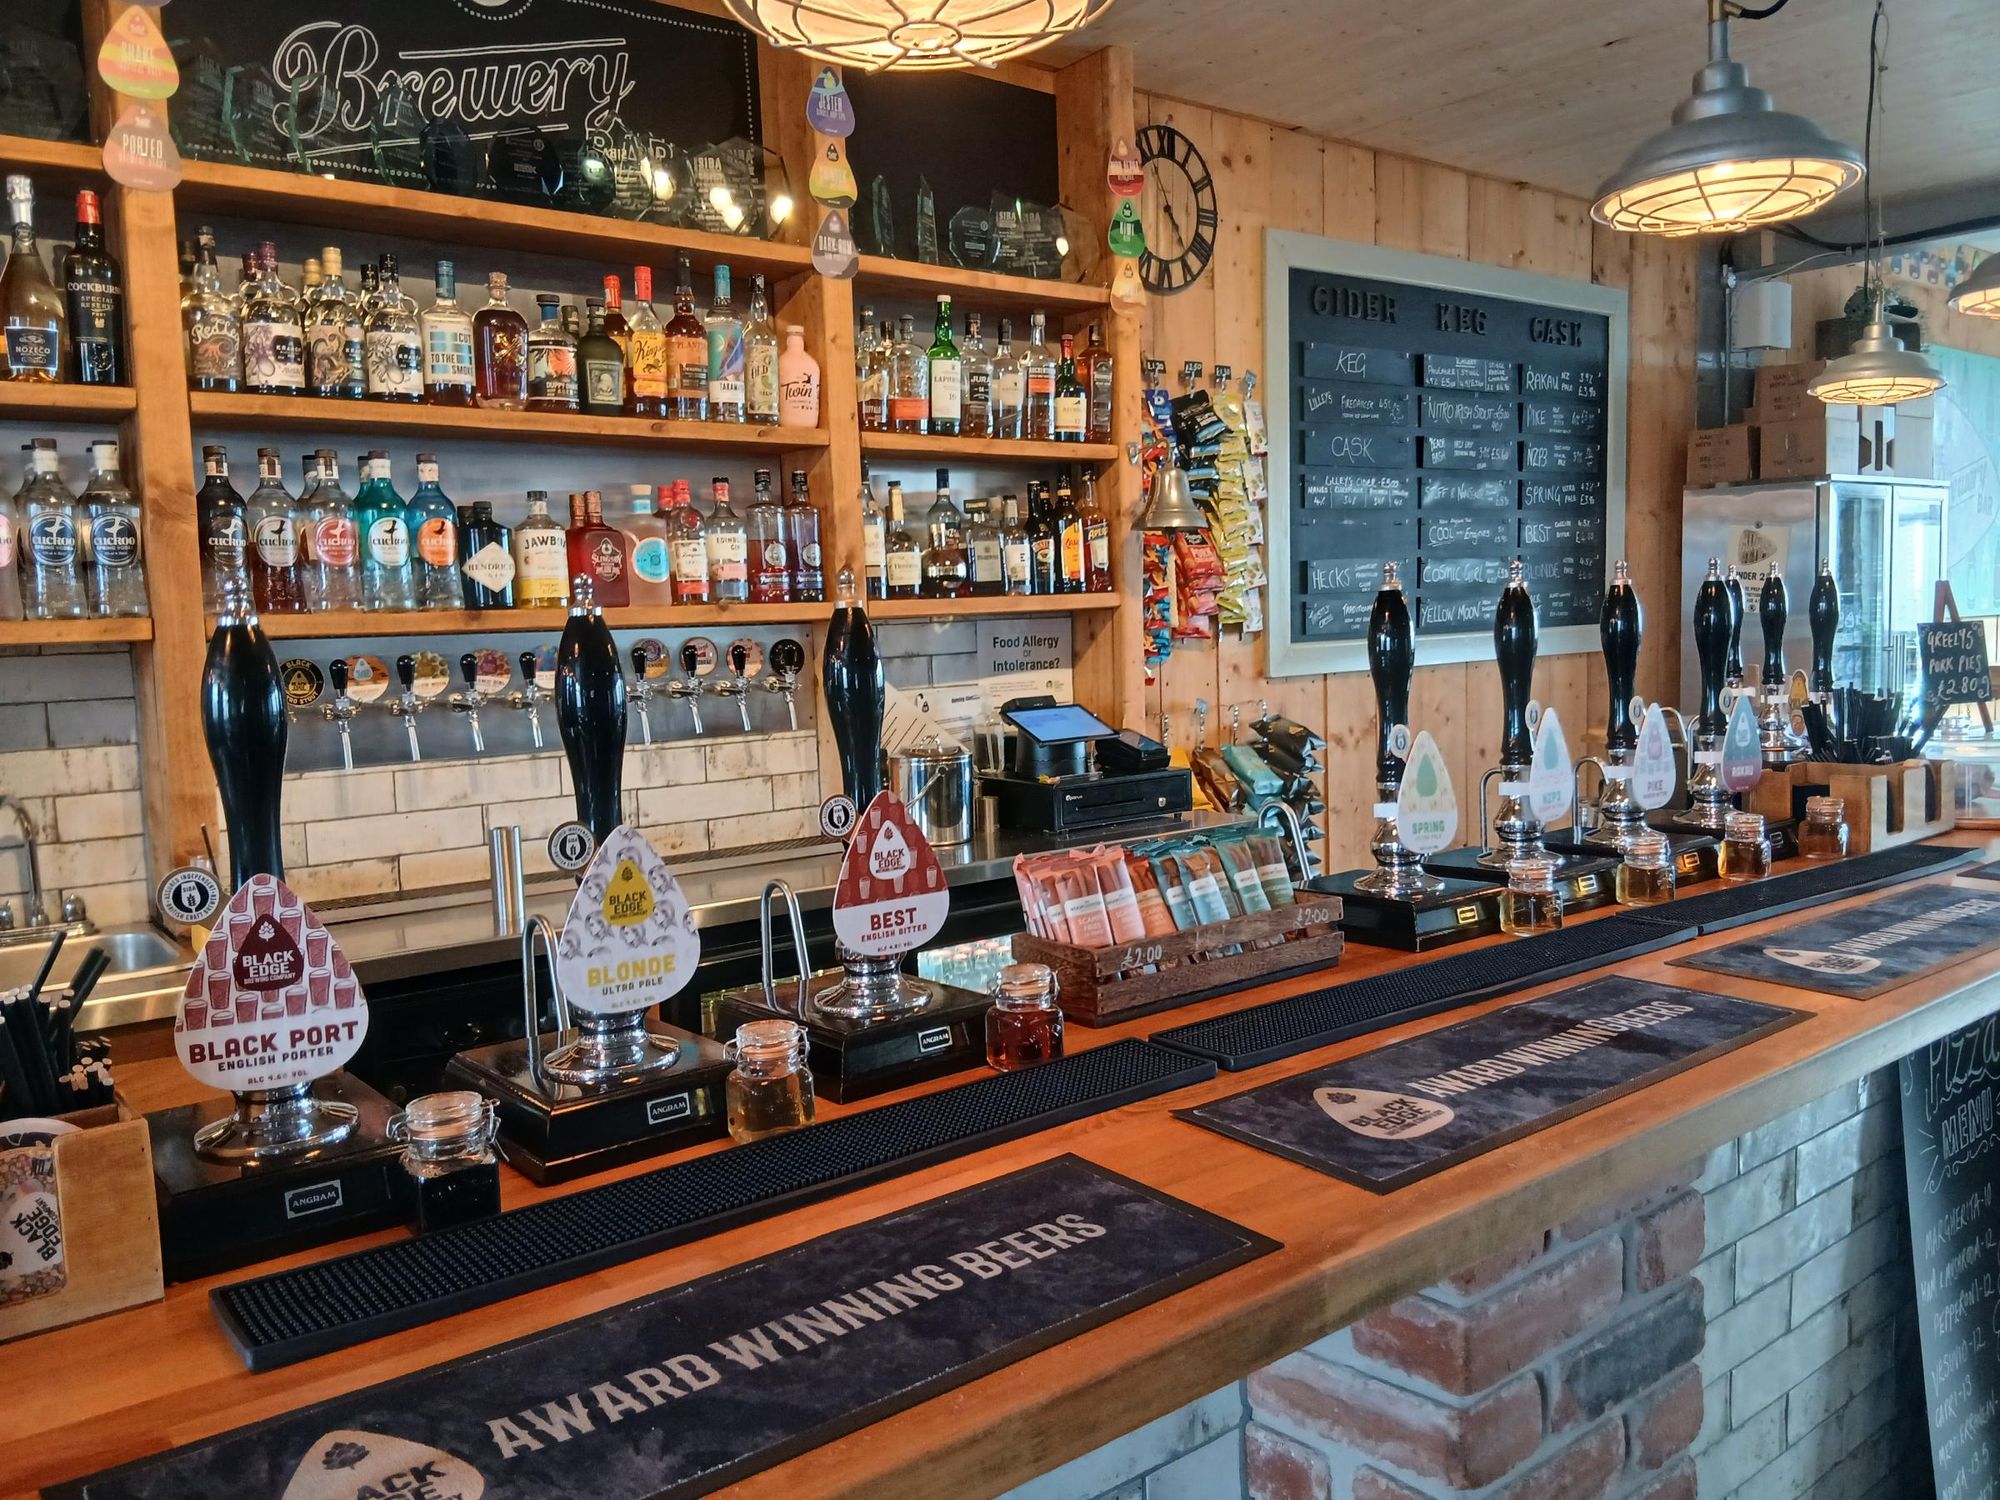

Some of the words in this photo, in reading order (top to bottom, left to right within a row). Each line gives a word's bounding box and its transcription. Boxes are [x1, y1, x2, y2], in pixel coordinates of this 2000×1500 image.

[272, 21, 636, 137] Brewery
[1312, 286, 1398, 323] CIDER
[1438, 303, 1488, 336] KEG
[1530, 317, 1583, 347] CASK
[15, 346, 51, 354] NOZECO
[431, 354, 440, 363] TO
[441, 354, 455, 364] THE
[1336, 350, 1367, 378] KEG
[1526, 371, 1559, 391] RAKAU
[1428, 402, 1454, 424] NITRO
[1526, 407, 1546, 428] PIKE
[1332, 436, 1375, 463] CASK
[1525, 486, 1561, 507] SPRING
[1525, 524, 1552, 544] BEST
[1312, 567, 1350, 590] HECKS
[1422, 563, 1461, 583] COSMIC
[1523, 562, 1561, 581] BLONDE
[1421, 605, 1455, 627] YELLOW
[1458, 601, 1481, 622] MOON
[993, 635, 1020, 649] Food
[1022, 634, 1060, 653] Allergy
[1022, 649, 1033, 658] or
[993, 657, 1061, 673] Intolerance?
[1929, 656, 1954, 676] PORK
[1958, 654, 1982, 674] PIES
[1411, 820, 1446, 835] SPRING
[874, 848, 905, 862] BLACK
[878, 857, 902, 869] EDGE
[609, 891, 648, 906] BLACK
[613, 902, 643, 915] EDGE
[870, 907, 917, 931] BEST
[861, 930, 896, 944] ENGLISH
[898, 923, 928, 937] BITTER
[242, 950, 295, 967] BLACK
[243, 976, 269, 985] BREWING
[269, 972, 296, 983] COMPANY
[249, 963, 290, 978] EDGE
[587, 954, 677, 988] BLONDE
[602, 984, 636, 996] ULTRA
[638, 977, 664, 990] PALE
[189, 1031, 278, 1064] BLACK
[288, 1020, 359, 1049] PORT
[1406, 1057, 1527, 1098] AWARD
[1507, 1018, 1618, 1067] WINNING
[1601, 1001, 1695, 1032] BEERS
[217, 1053, 277, 1072] ENGLISH
[281, 1046, 334, 1063] PORTER
[652, 1100, 687, 1116] ANGRAM
[1348, 1097, 1419, 1127] BLACK
[1372, 1103, 1429, 1131] EDGE
[1942, 1086, 1994, 1160] MENU
[292, 1190, 337, 1208] ANGRAM
[9, 1212, 58, 1262] BLACK
[25, 1206, 61, 1247] EDGE
[484, 1353, 722, 1459] AWARD
[707, 1264, 964, 1371] WINNING
[947, 1212, 1107, 1281] BEERS
